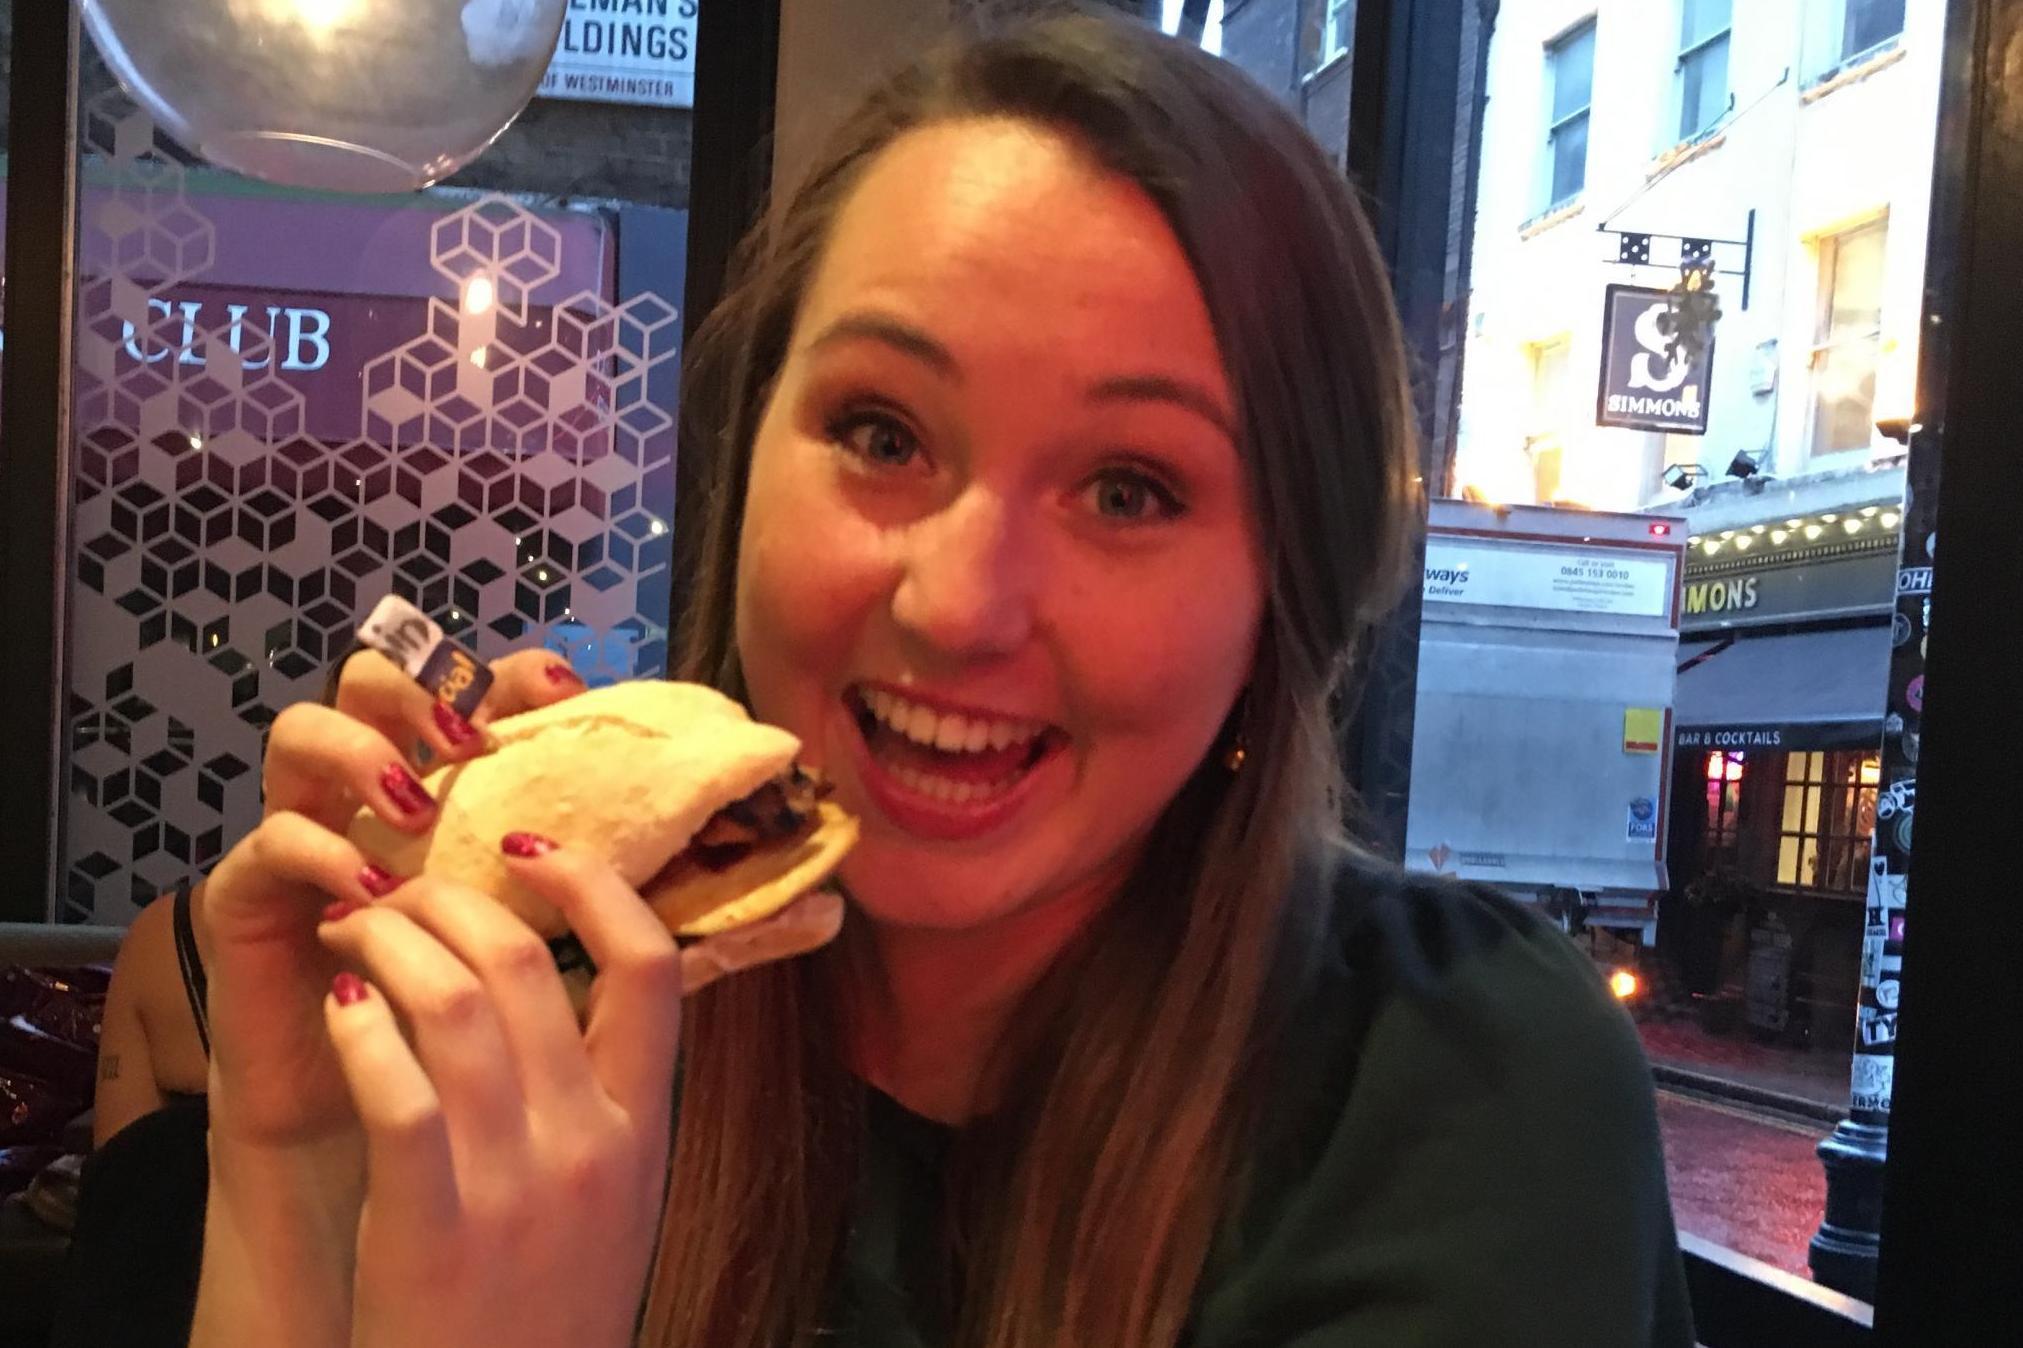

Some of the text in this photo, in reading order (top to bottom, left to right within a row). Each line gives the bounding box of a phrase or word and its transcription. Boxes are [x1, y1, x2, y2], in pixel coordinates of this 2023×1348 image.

[564, 73, 674, 97] WESTMINSTER
[122, 298, 331, 371] CLUB
[1426, 568, 1470, 585] ways
[1682, 577, 1757, 615] MONS
[1678, 732, 1701, 745] BAR
[1715, 730, 1781, 745] COCKTAILS
